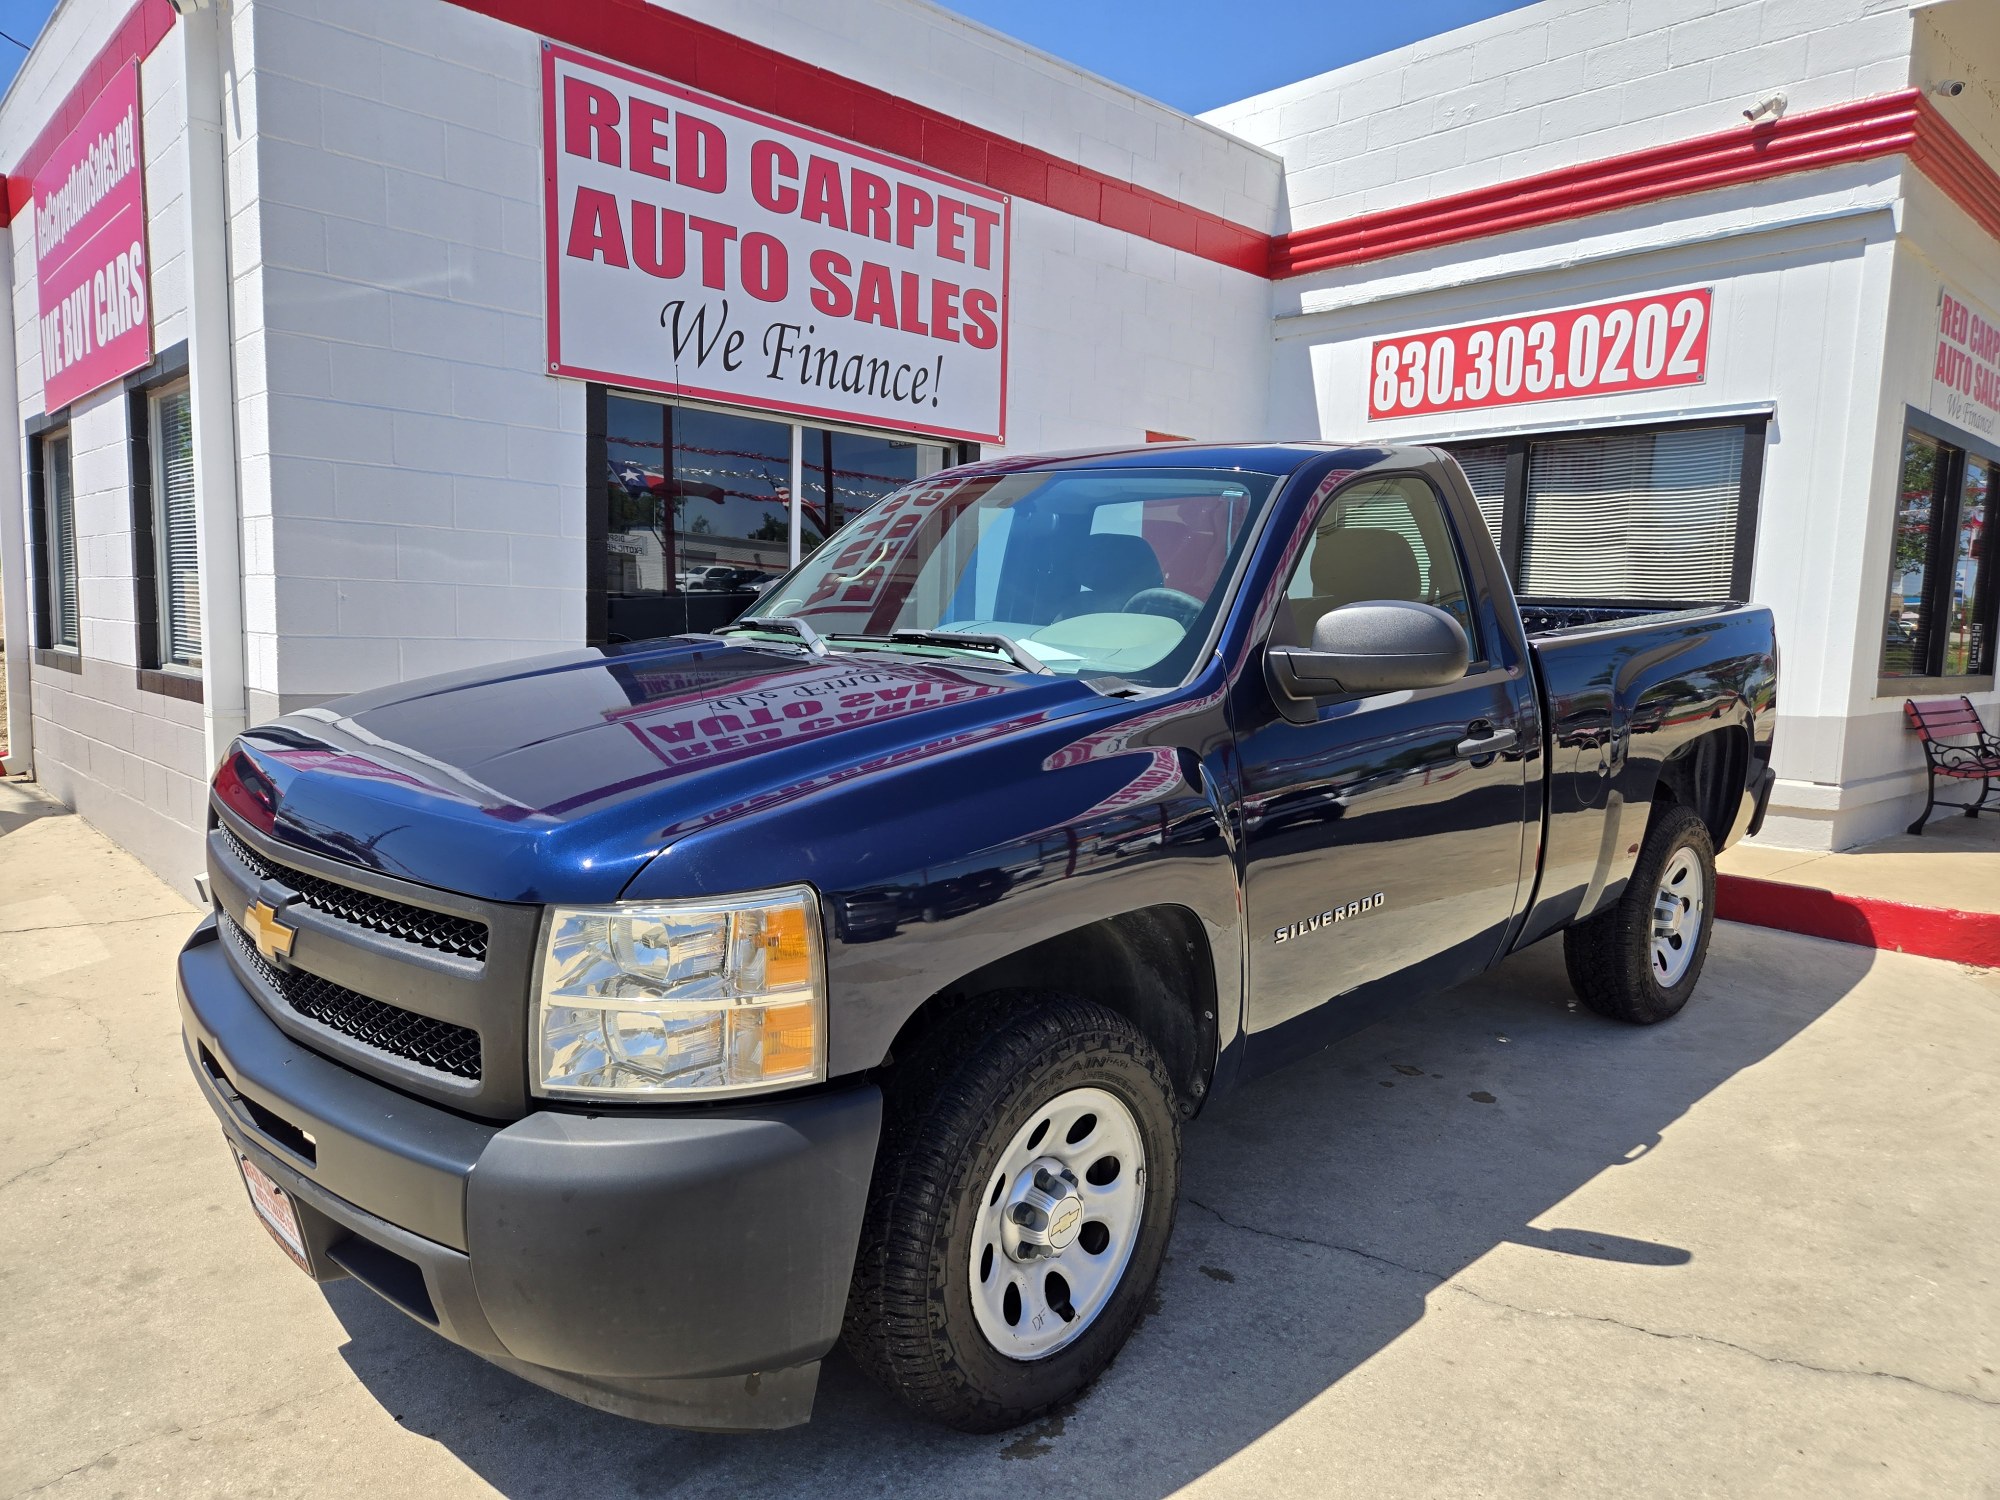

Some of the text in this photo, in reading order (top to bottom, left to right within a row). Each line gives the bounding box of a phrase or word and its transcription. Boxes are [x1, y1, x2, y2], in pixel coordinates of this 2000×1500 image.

[36, 104, 135, 262] RedCarpetAutoSales.net
[563, 75, 1000, 270] RED CARPET
[41, 240, 145, 382] WE BUY CARS
[566, 186, 998, 350] AUTO SALES
[660, 299, 943, 408] We Finance!
[1373, 298, 1705, 412] 830.303.0202
[1935, 341, 2000, 414] AUTO SALE
[1940, 294, 2000, 369] RED CARP
[1947, 393, 1961, 420] We
[1274, 892, 1385, 944] SILVERADO
